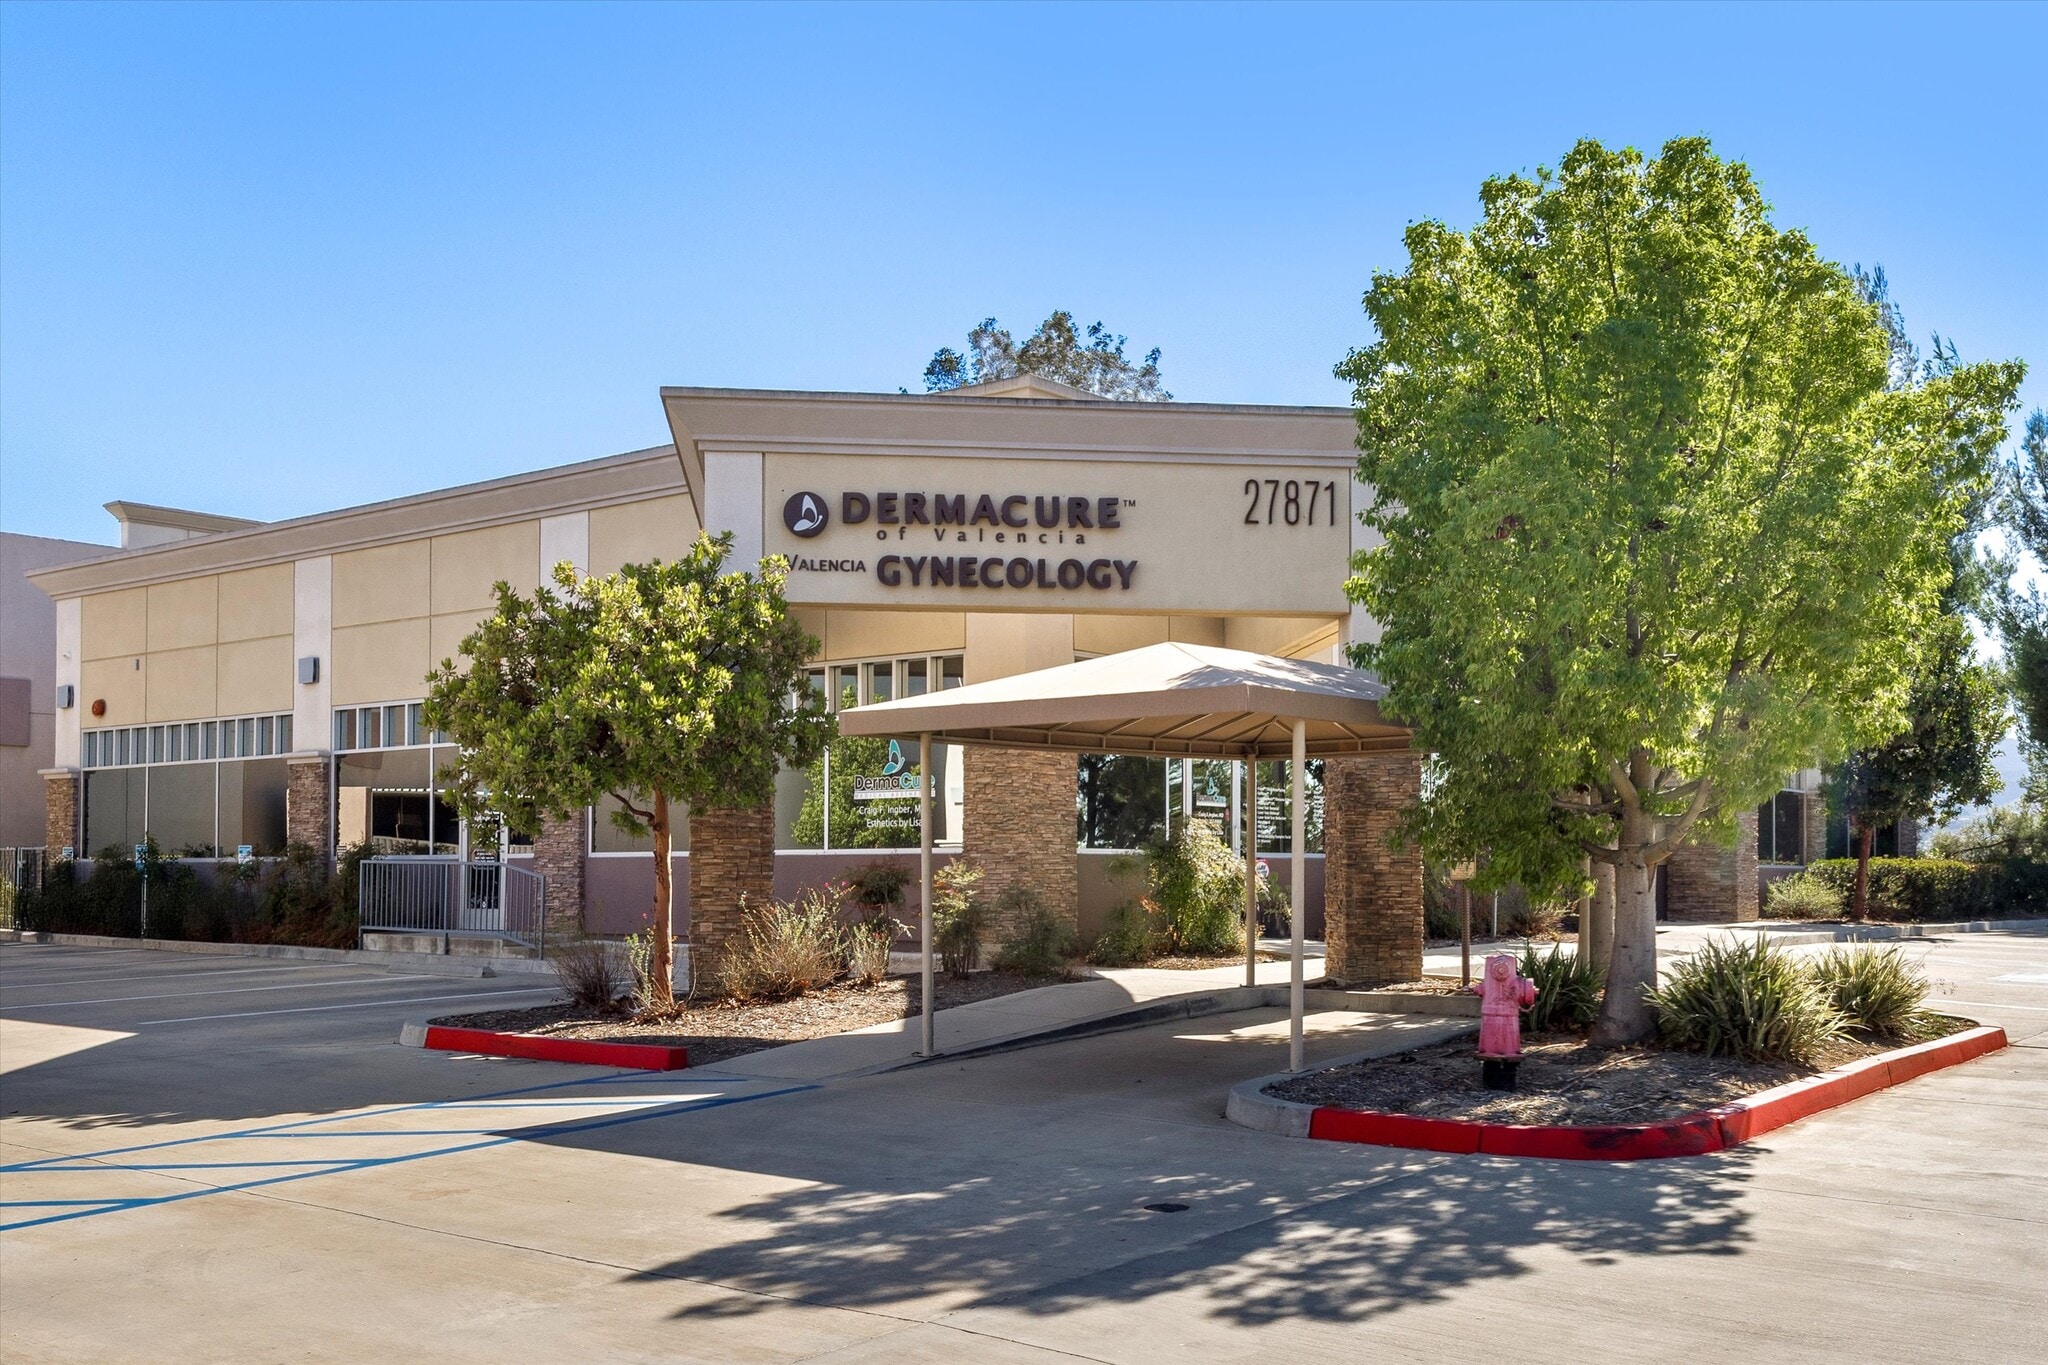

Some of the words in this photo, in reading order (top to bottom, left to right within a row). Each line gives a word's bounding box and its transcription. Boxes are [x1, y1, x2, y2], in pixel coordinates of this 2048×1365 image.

[842, 491, 1121, 529] DERMACURE
[1244, 479, 1335, 527] 27871
[876, 526, 906, 541] of
[934, 527, 1086, 545] Valencia
[784, 554, 867, 573] VALENCIA
[876, 554, 1138, 590] GYNECOLOGY
[854, 772, 936, 790] DermaCu
[859, 805, 877, 815] Craig
[866, 818, 897, 828] Esthetics
[898, 817, 908, 829] by
